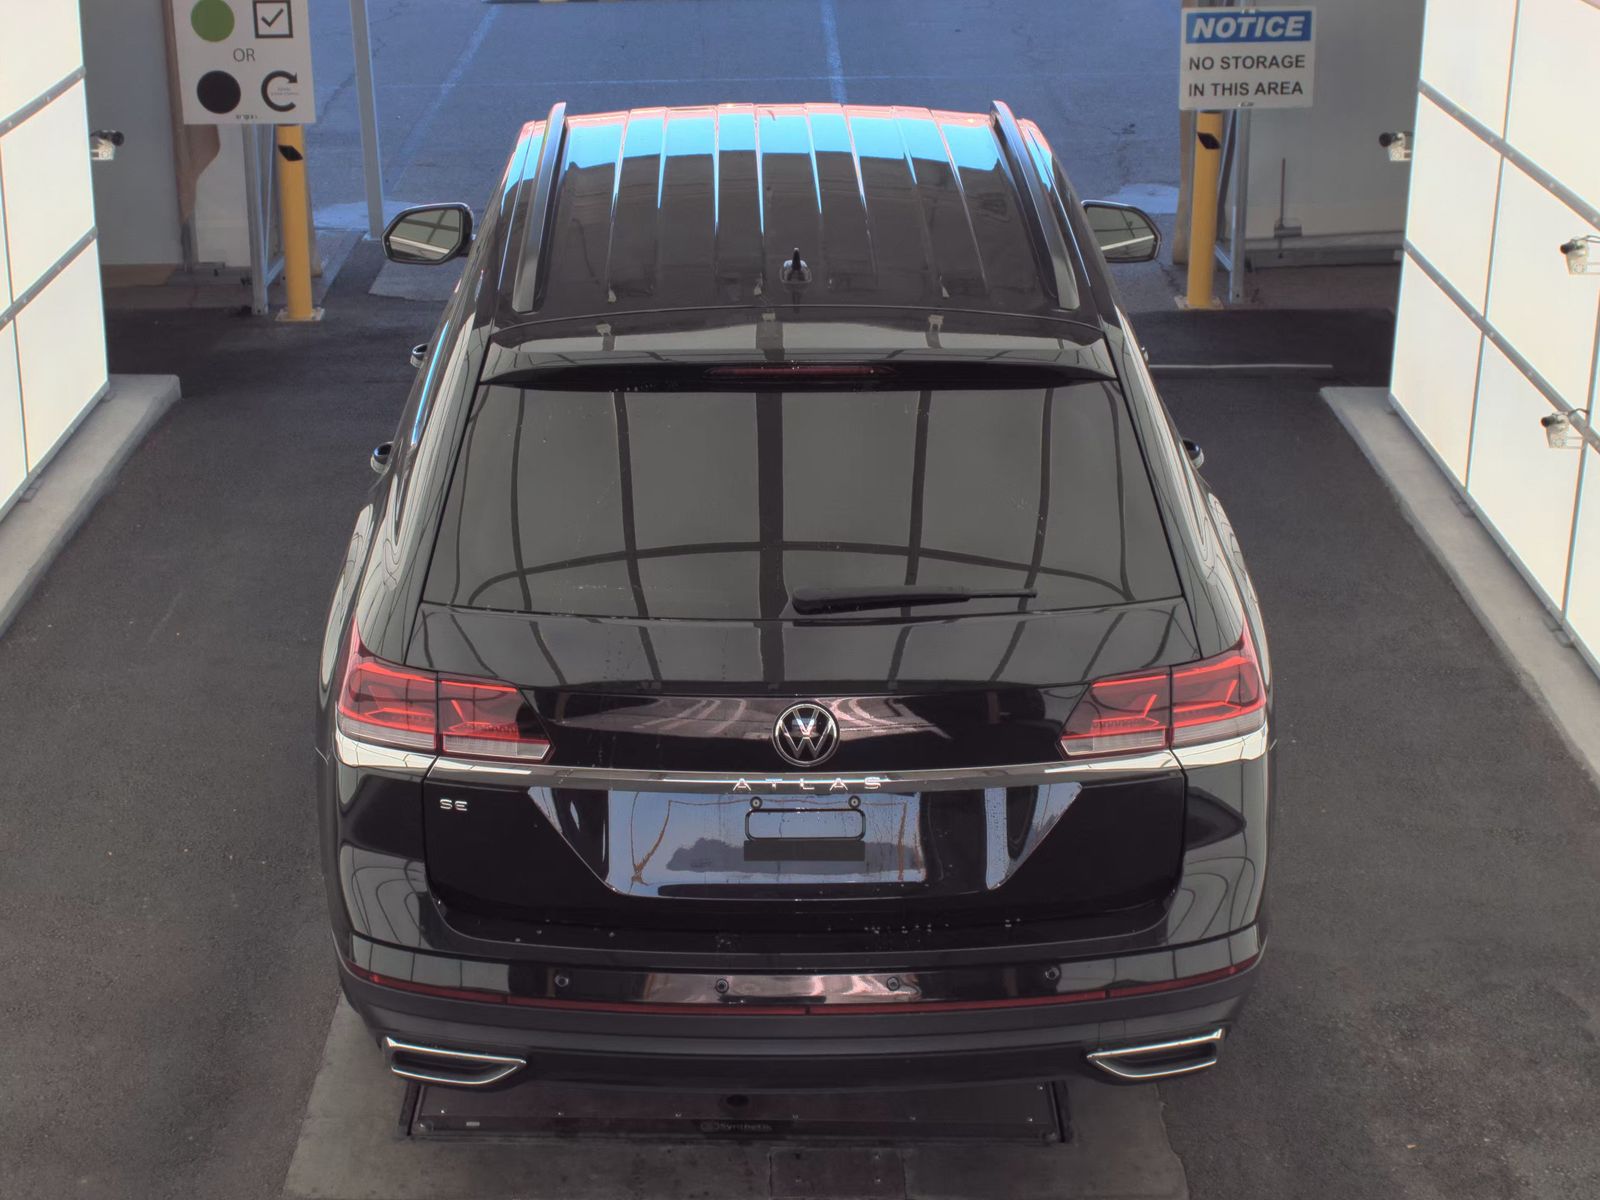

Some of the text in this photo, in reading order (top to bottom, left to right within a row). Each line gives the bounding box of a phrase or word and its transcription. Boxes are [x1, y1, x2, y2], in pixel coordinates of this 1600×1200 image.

[1192, 16, 1305, 38] NOTICE
[233, 47, 256, 62] OR
[1189, 55, 1306, 70] NO STORAGE
[1188, 81, 1303, 97] IN THIS AREA
[774, 703, 837, 764] VW
[732, 776, 882, 791] ATLAS
[440, 798, 467, 811] SE
